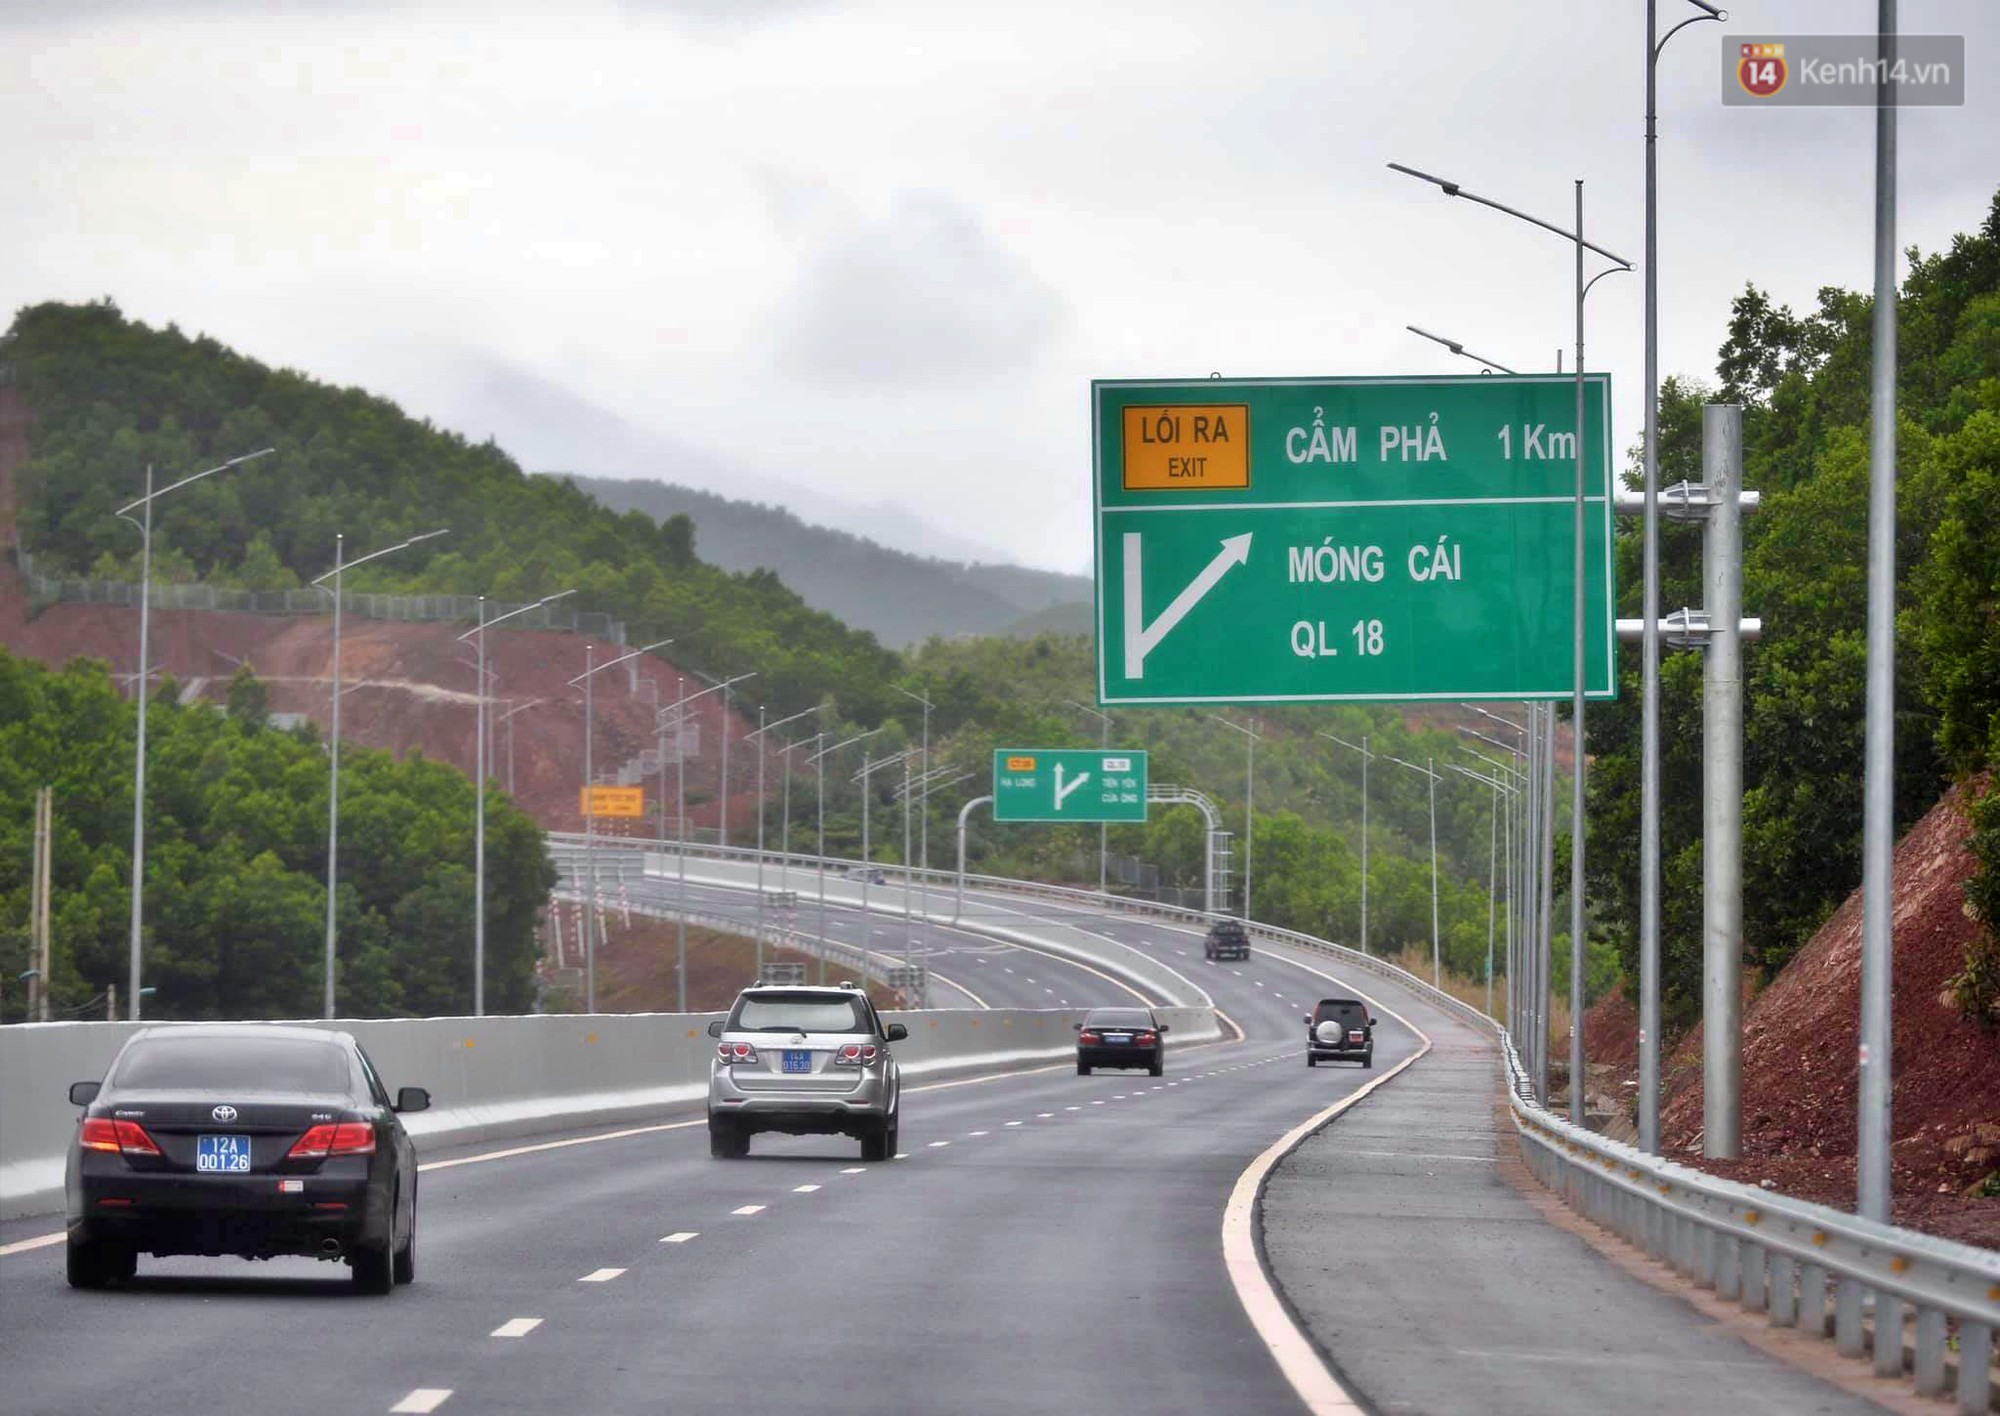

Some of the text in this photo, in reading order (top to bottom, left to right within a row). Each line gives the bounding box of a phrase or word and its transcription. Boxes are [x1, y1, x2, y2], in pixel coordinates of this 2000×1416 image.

[1142, 409, 1229, 443] LỐI RA
[1286, 406, 1577, 463] CẨM PHẢ 1 Km
[1168, 457, 1208, 477] EXIT
[1289, 535, 1461, 583] MÓNG CÁI
[1291, 619, 1384, 659] QL 18
[212, 1137, 238, 1154] 12A
